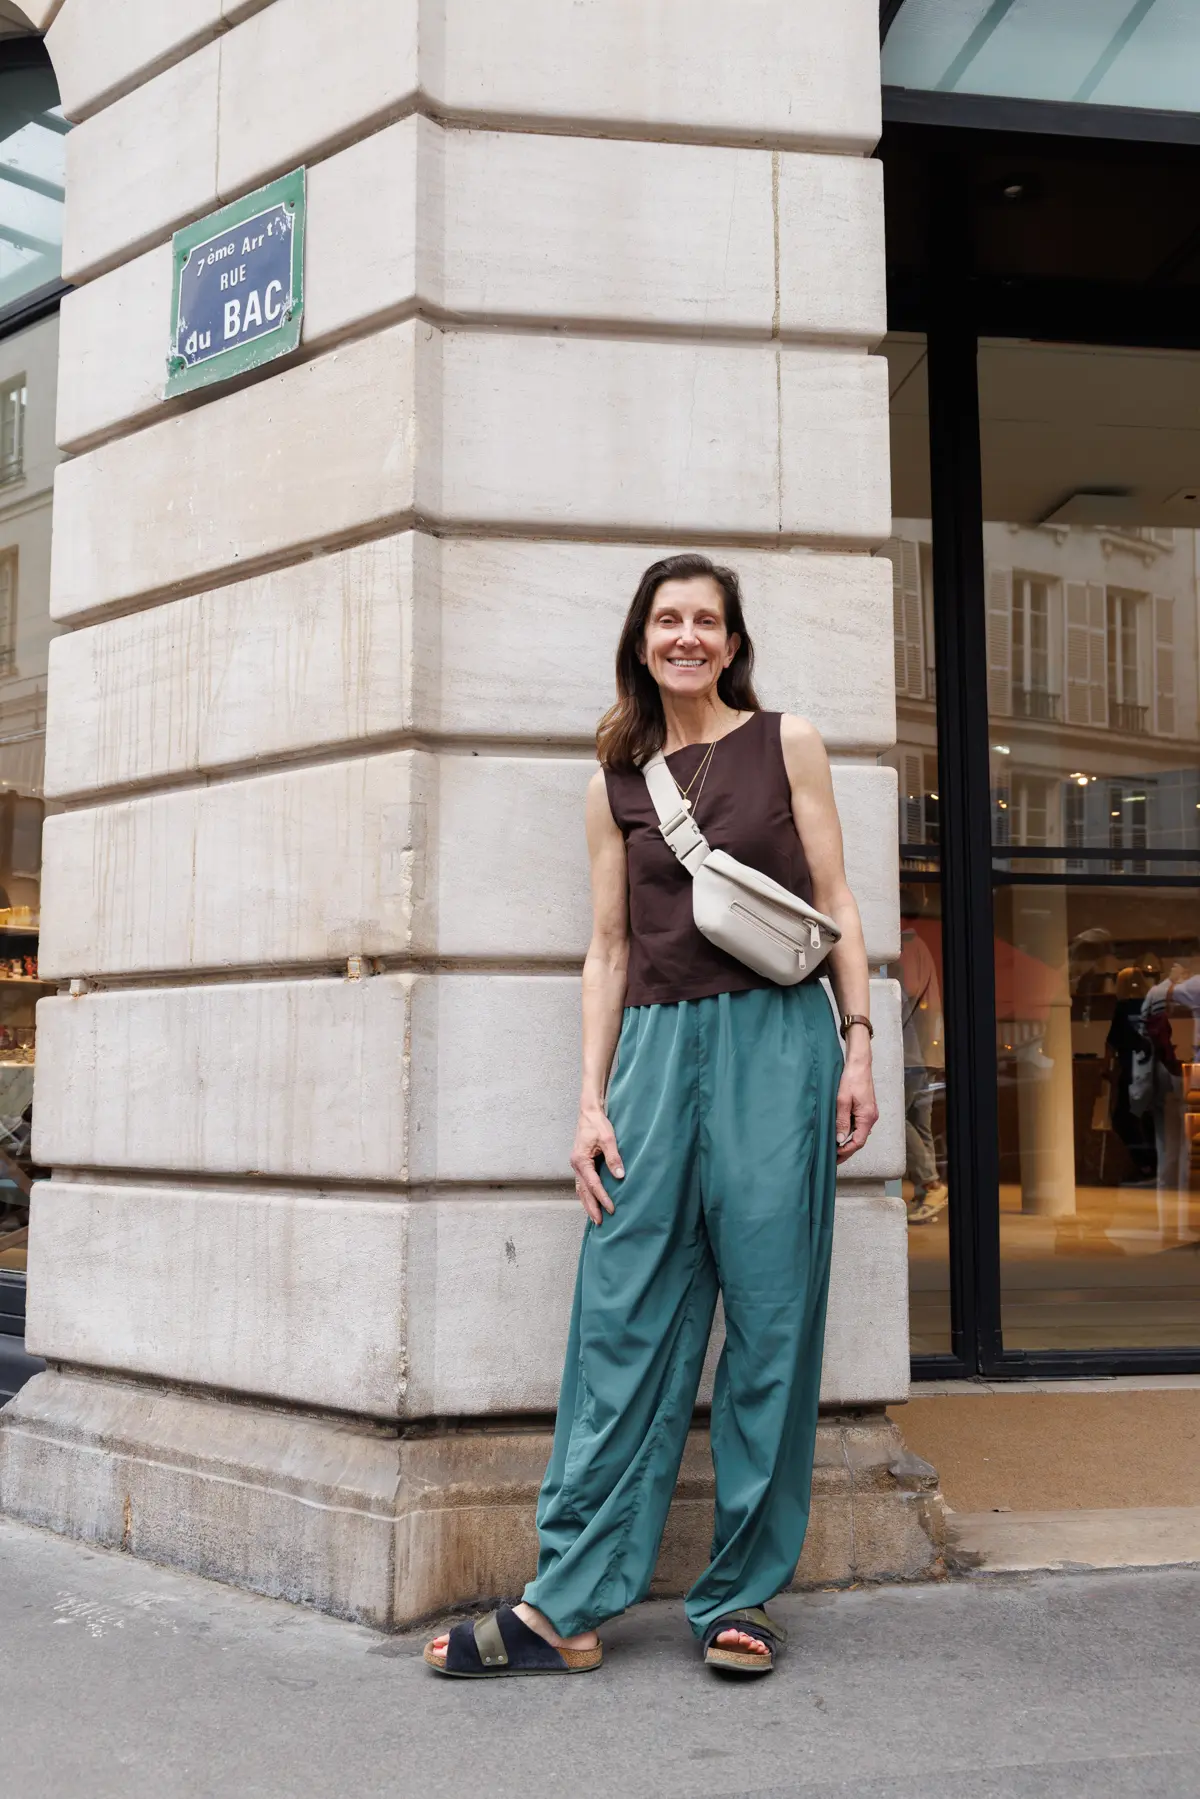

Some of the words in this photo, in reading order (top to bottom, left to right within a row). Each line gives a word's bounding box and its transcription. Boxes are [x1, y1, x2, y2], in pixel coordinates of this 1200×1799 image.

[197, 242, 236, 277] 7ème
[220, 264, 247, 291] RUE
[185, 328, 211, 355] du
[224, 279, 283, 341] BAC
